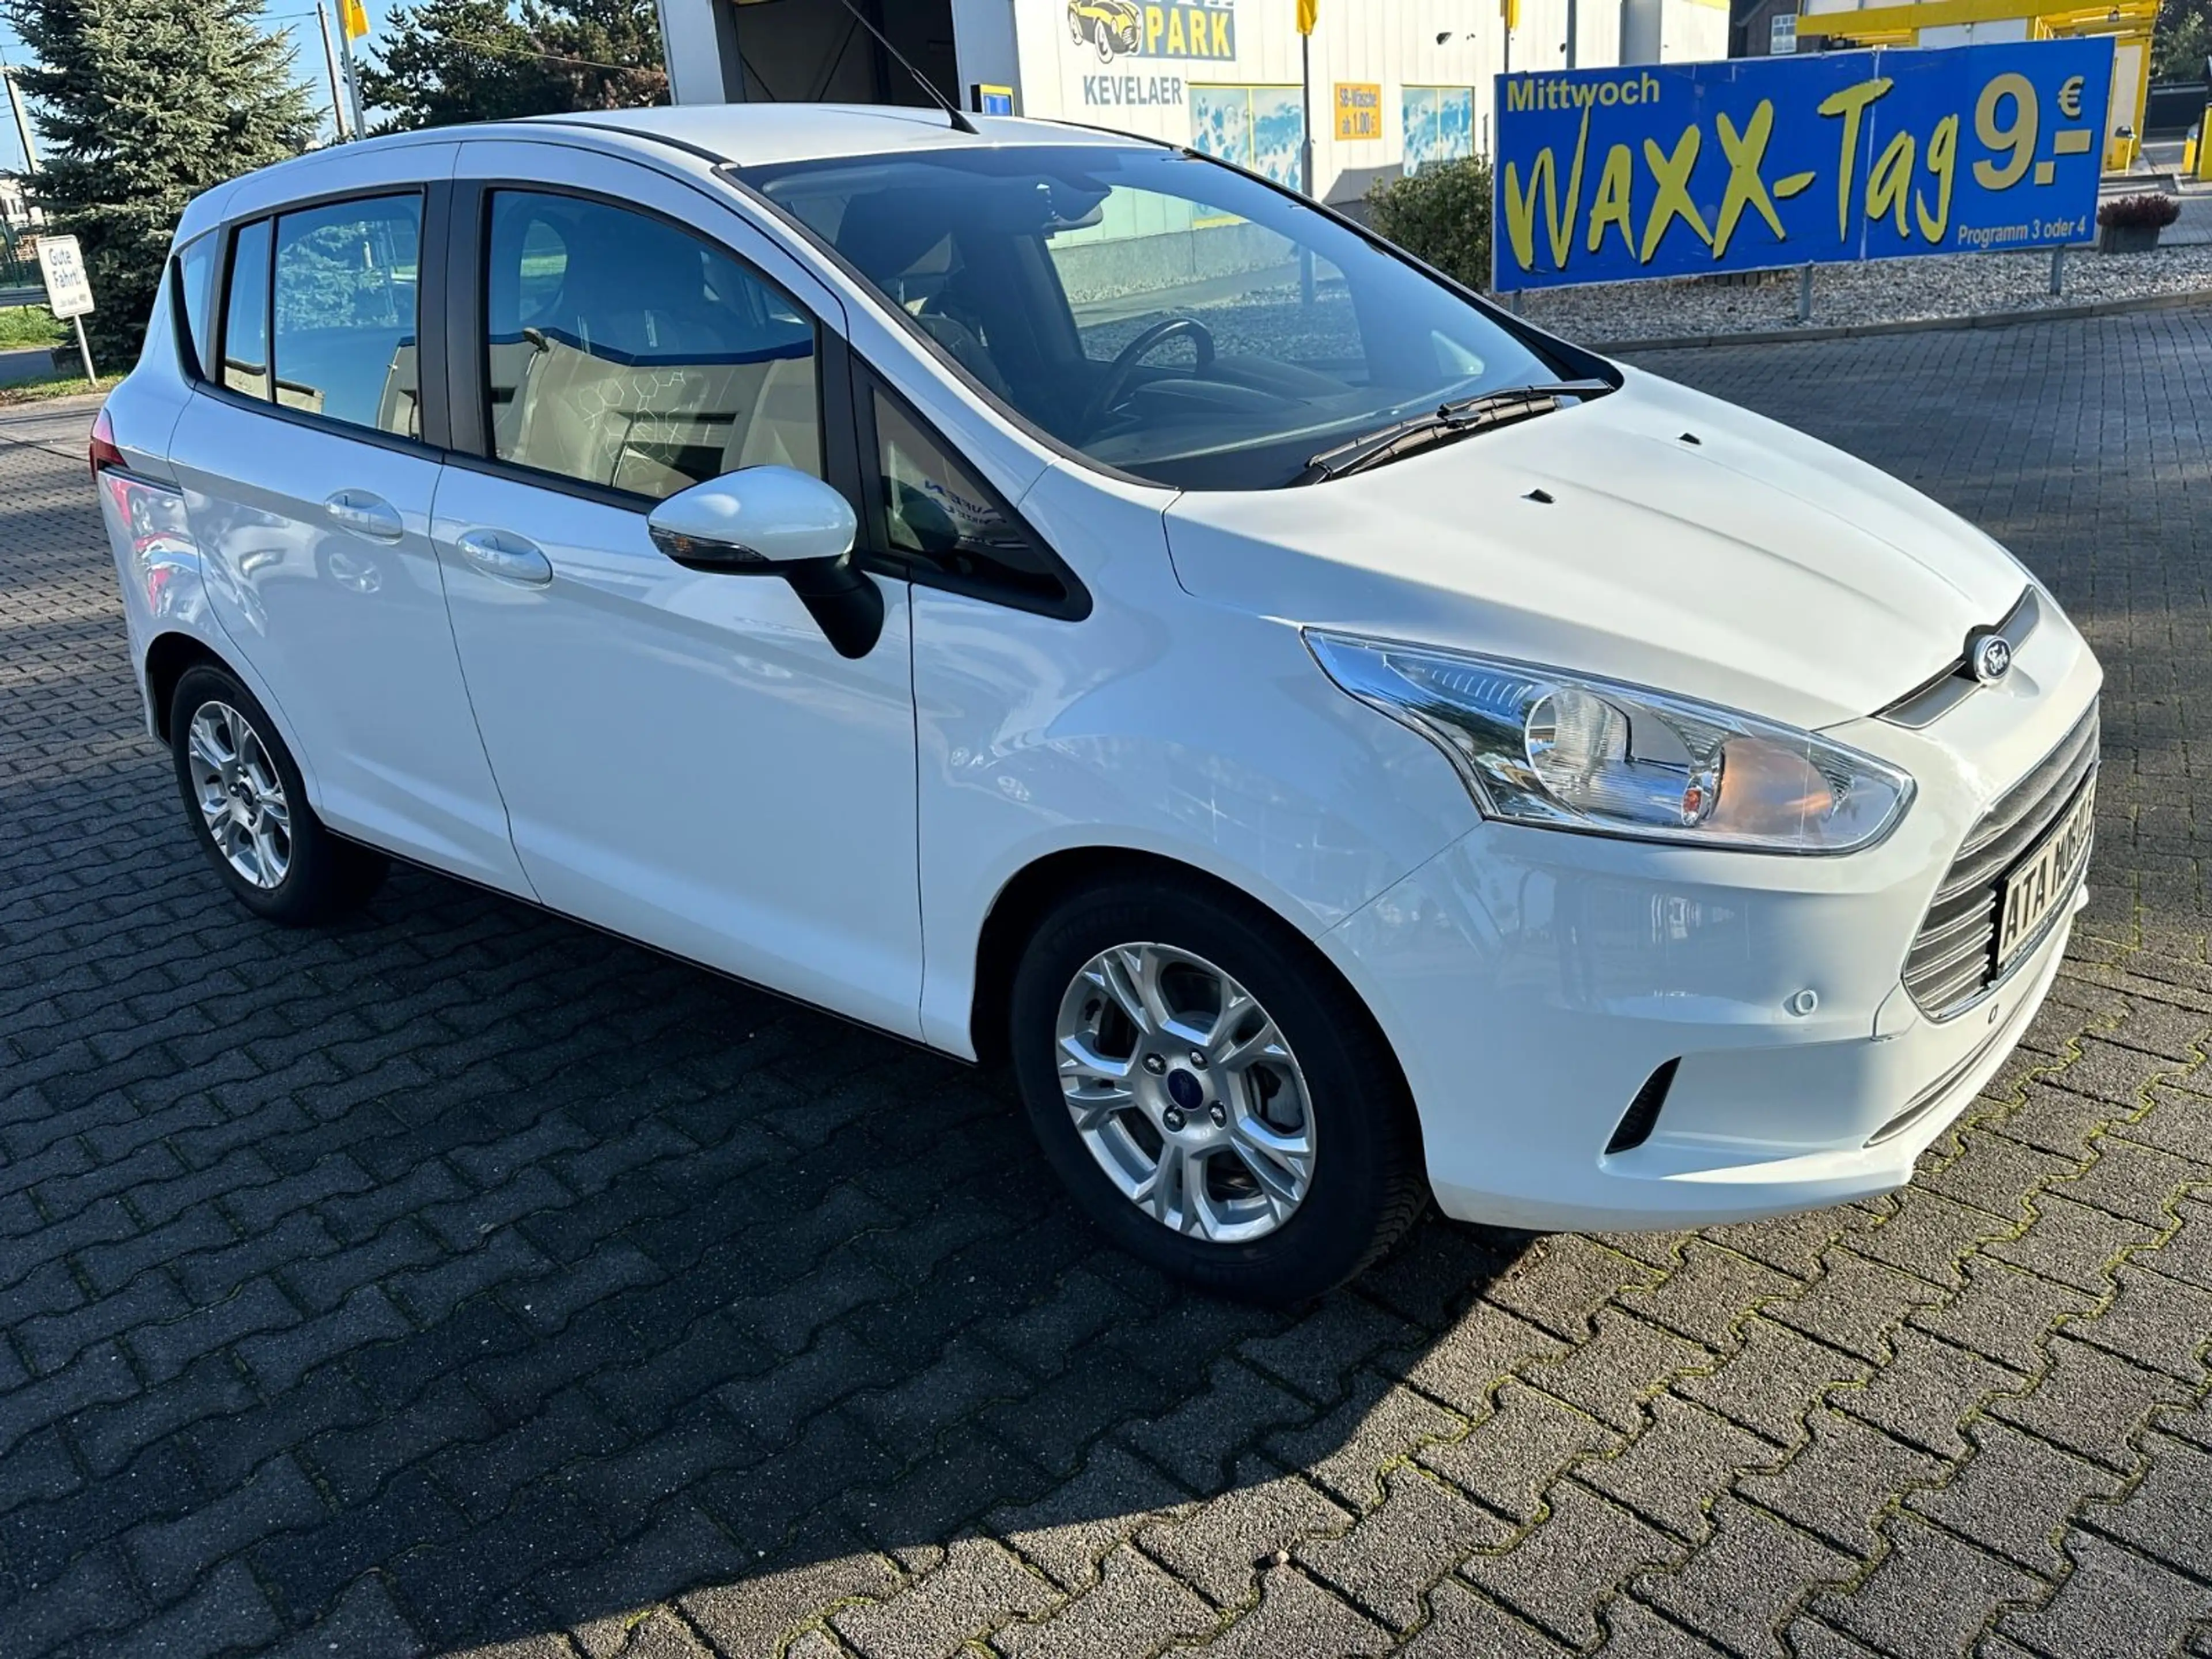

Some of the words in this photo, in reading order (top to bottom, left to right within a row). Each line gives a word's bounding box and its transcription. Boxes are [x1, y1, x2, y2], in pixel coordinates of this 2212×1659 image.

[1145, 6, 1232, 56] PARK
[1083, 75, 1183, 105] KEVELAER
[1507, 73, 1660, 112] Mittwoch
[1959, 224, 2028, 249] Programm
[2031, 221, 2040, 240] 3
[2044, 217, 2075, 238] oder
[2077, 215, 2086, 235] 4
[48, 247, 72, 266] Gute
[2003, 855, 2047, 950] ATA
